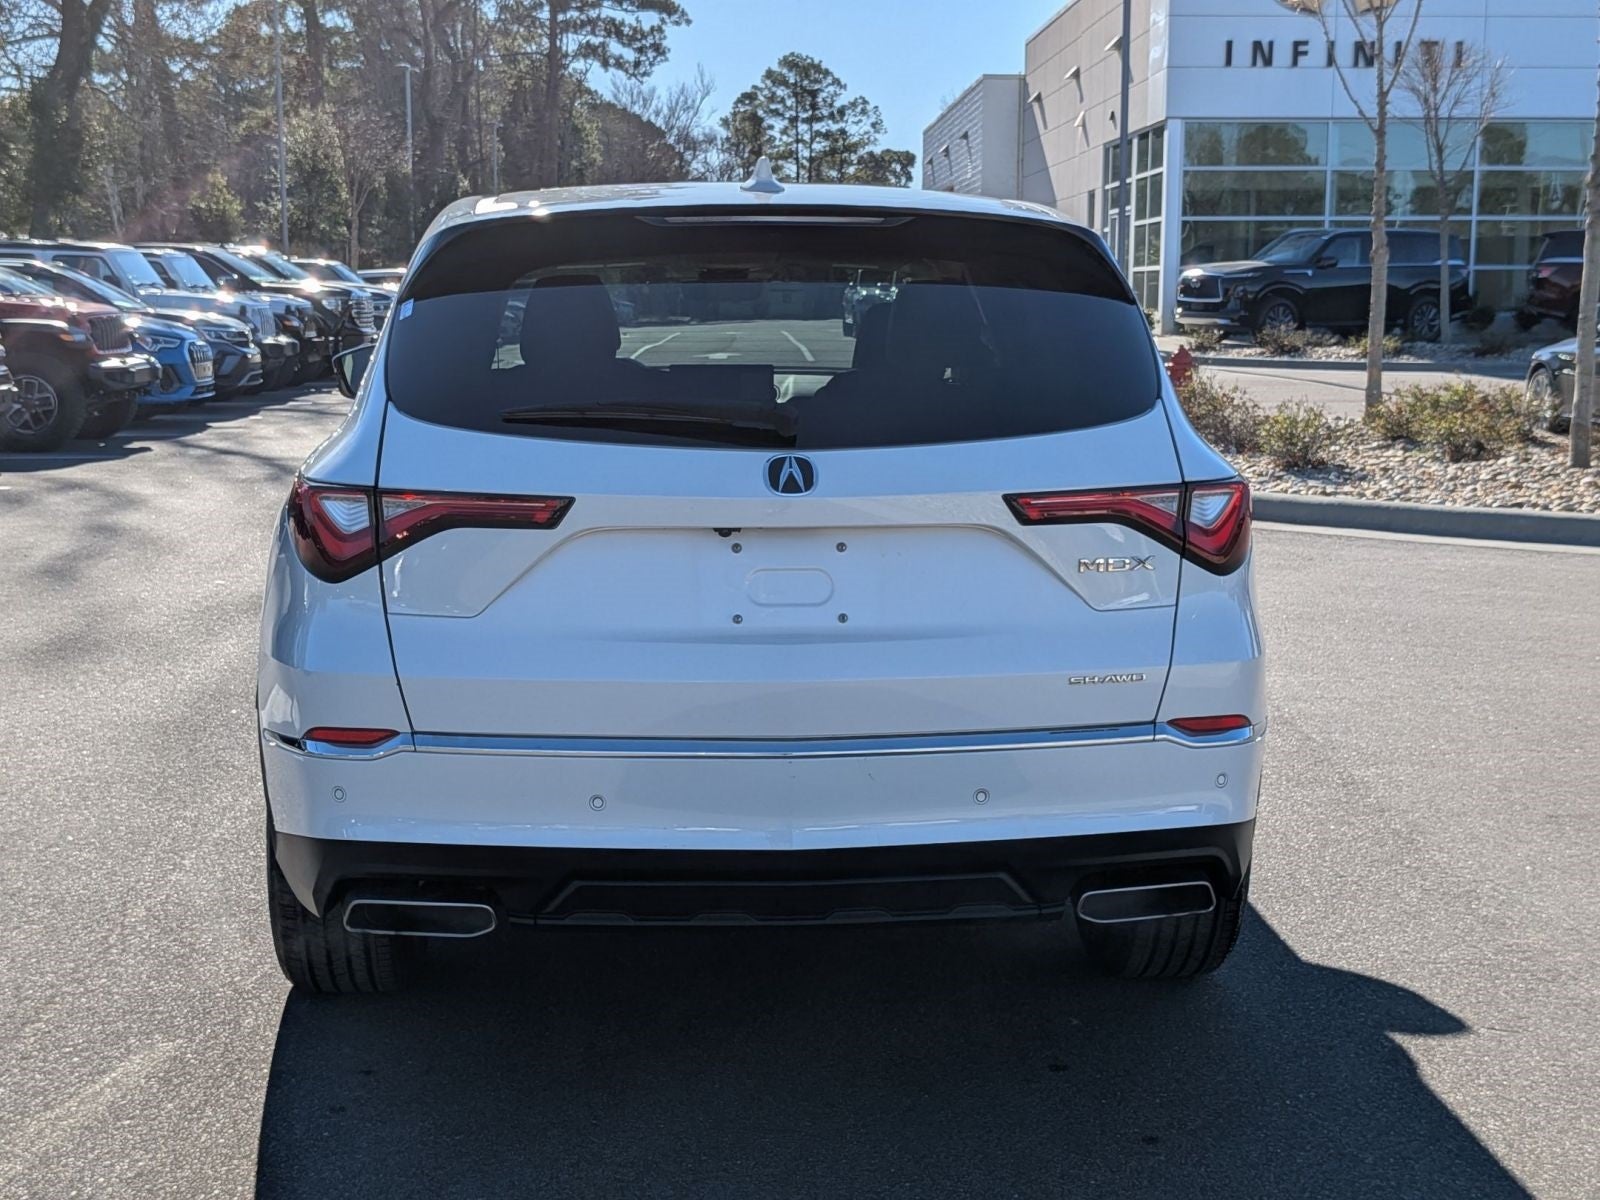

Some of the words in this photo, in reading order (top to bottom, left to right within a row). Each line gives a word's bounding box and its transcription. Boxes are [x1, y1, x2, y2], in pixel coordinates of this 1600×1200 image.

[1224, 39, 1464, 68] INFINITI
[1078, 555, 1155, 573] MDX
[1068, 672, 1147, 685] SH-AWD
